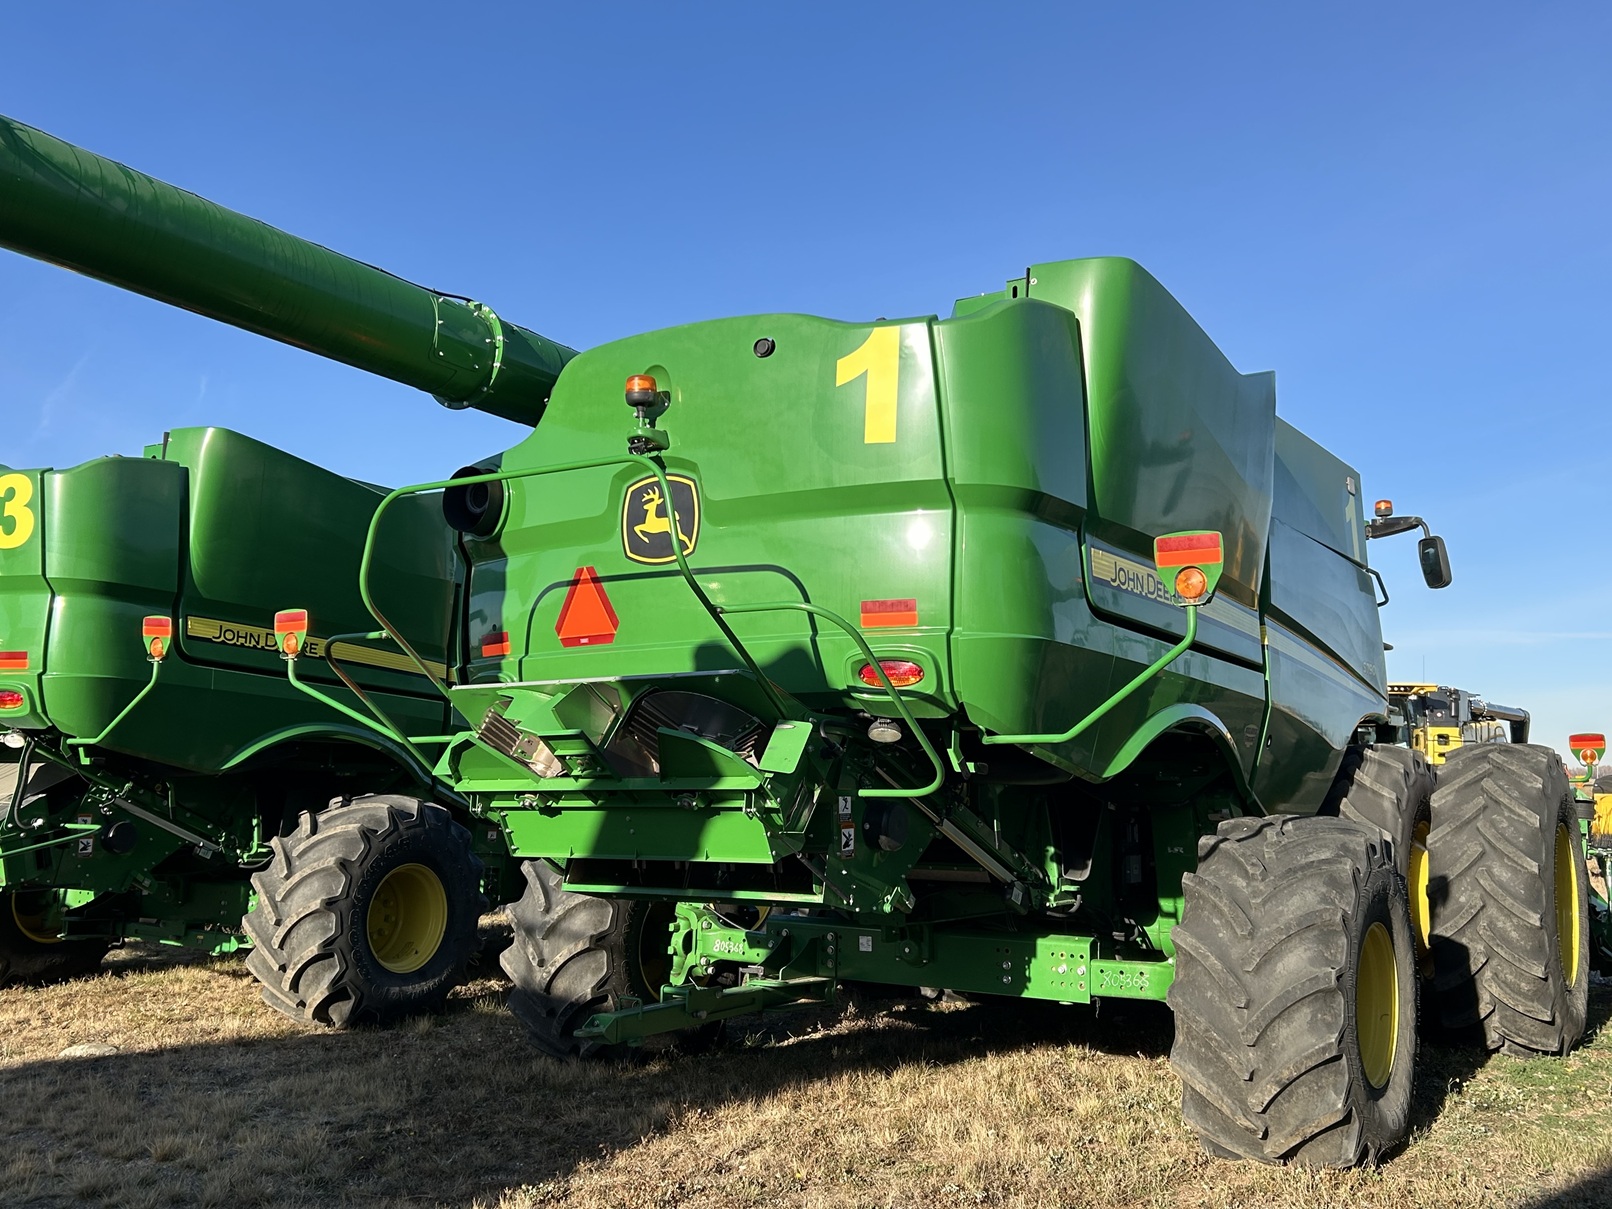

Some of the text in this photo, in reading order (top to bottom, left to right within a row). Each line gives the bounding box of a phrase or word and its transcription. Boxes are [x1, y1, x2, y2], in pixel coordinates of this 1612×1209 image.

[836, 325, 901, 445] 1
[0, 473, 35, 550] 3
[1110, 560, 1145, 594] JOHN
[211, 624, 319, 655] JOHN DRE
[713, 939, 744, 955] 805368
